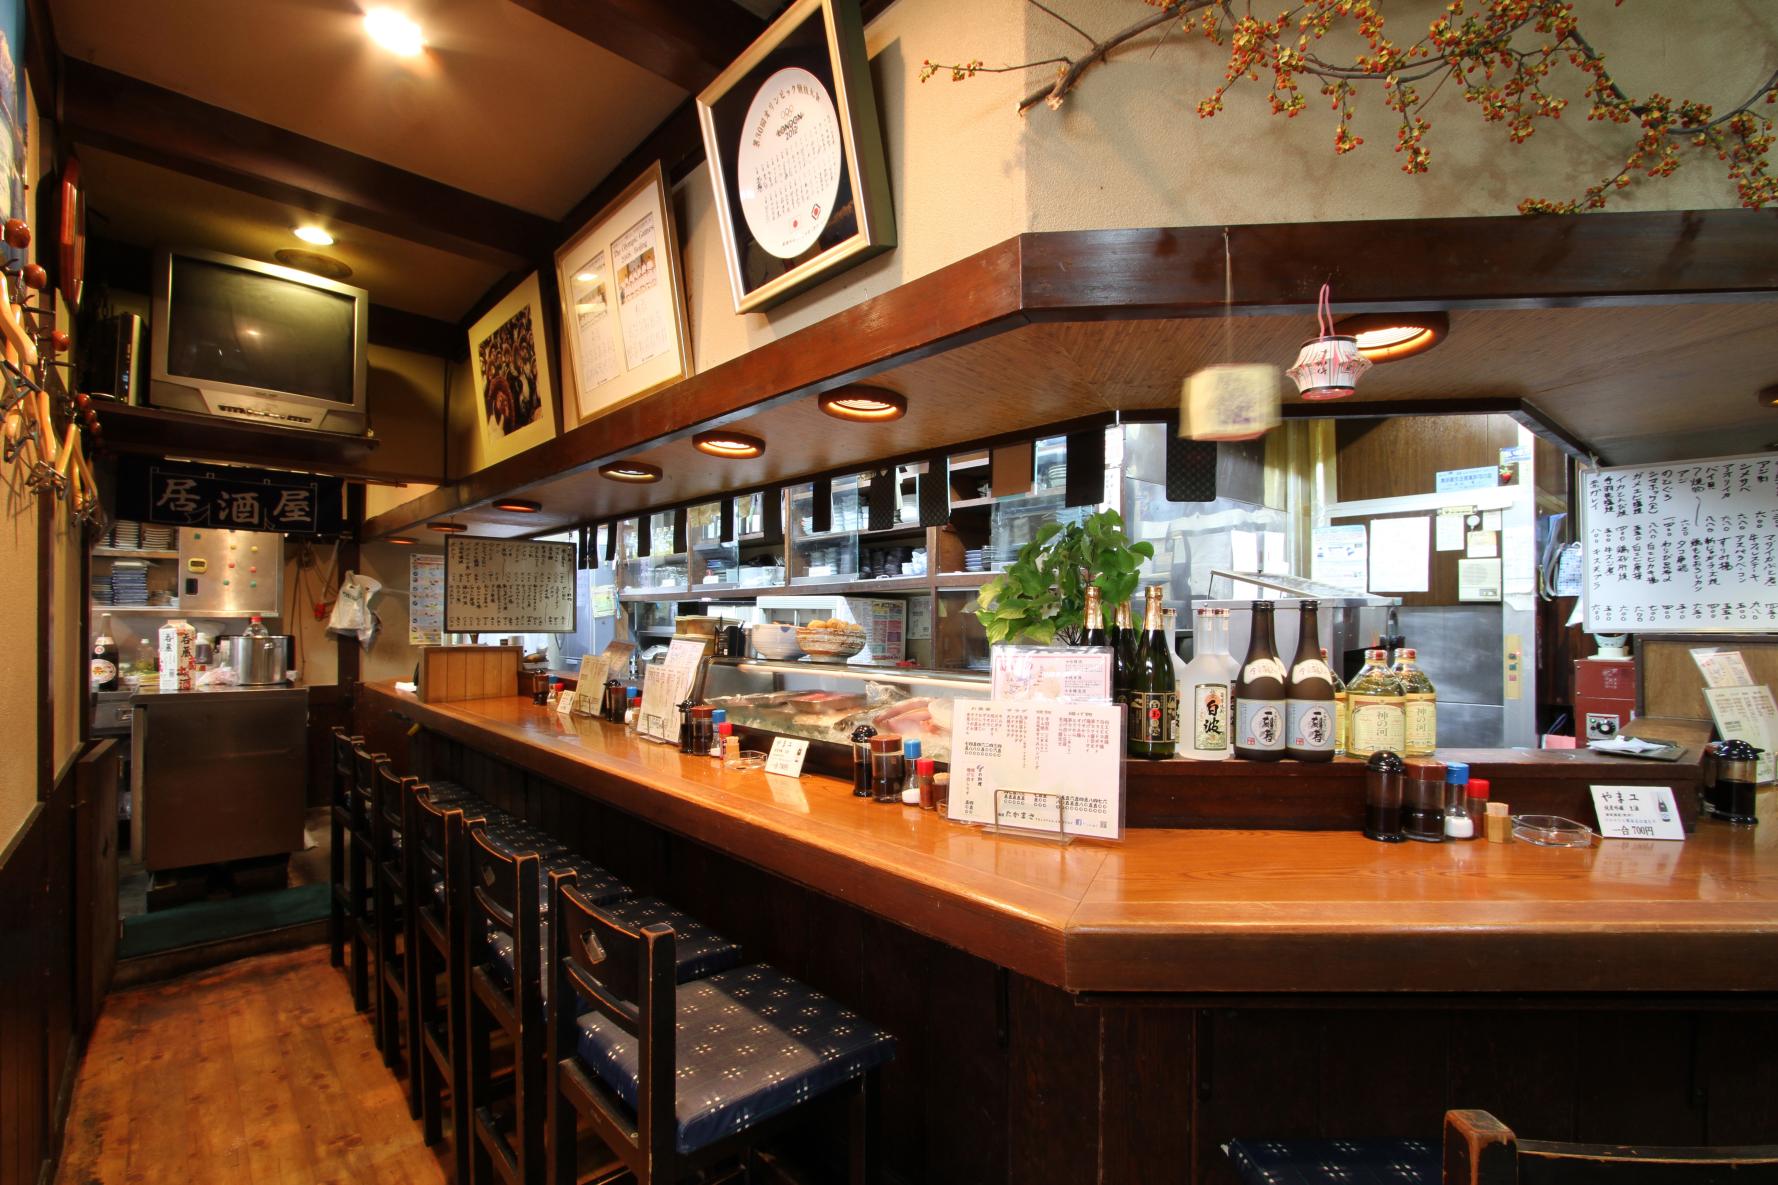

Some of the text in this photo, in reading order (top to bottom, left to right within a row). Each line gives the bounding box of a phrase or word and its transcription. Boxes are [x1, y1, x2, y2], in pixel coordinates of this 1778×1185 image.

[776, 112, 804, 137] LONDON
[785, 125, 798, 140] 2012
[156, 478, 314, 524] 居酒屋
[1203, 699, 1223, 735] 白波
[1262, 711, 1274, 742] 一刻者
[1311, 711, 1323, 742] 一刻者
[1376, 711, 1389, 736] 神の河
[1415, 708, 1427, 731] 神の河
[1006, 810, 1035, 820] たかまさ
[1612, 825, 1655, 836] 一合 700円
